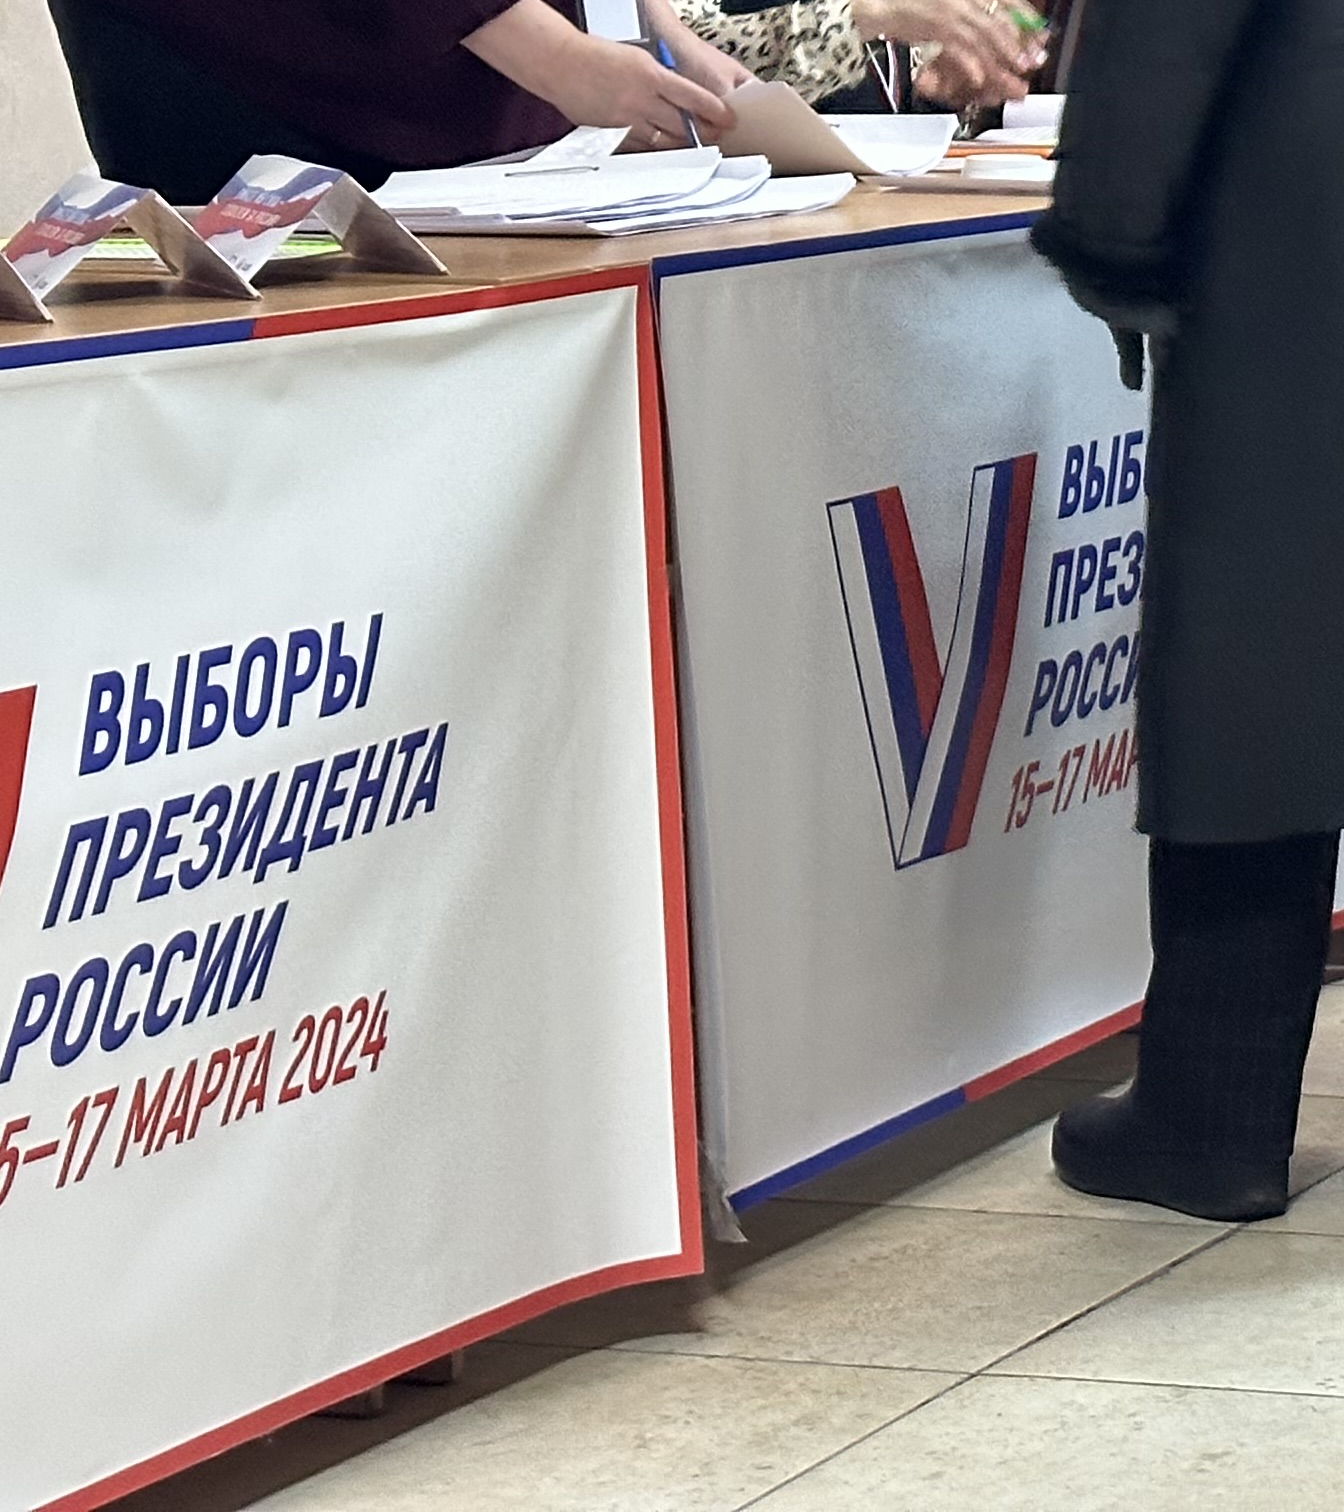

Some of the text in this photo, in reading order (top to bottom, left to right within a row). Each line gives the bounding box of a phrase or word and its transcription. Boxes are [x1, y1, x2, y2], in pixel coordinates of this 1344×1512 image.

[79, 613, 385, 776] ВЫБОРЫ
[42, 723, 449, 930] ПРЕЗИДЕНТА
[0, 901, 290, 1084] РОССИИ
[114, 1029, 277, 1168] МАРТА
[278, 989, 389, 1105] 2024
